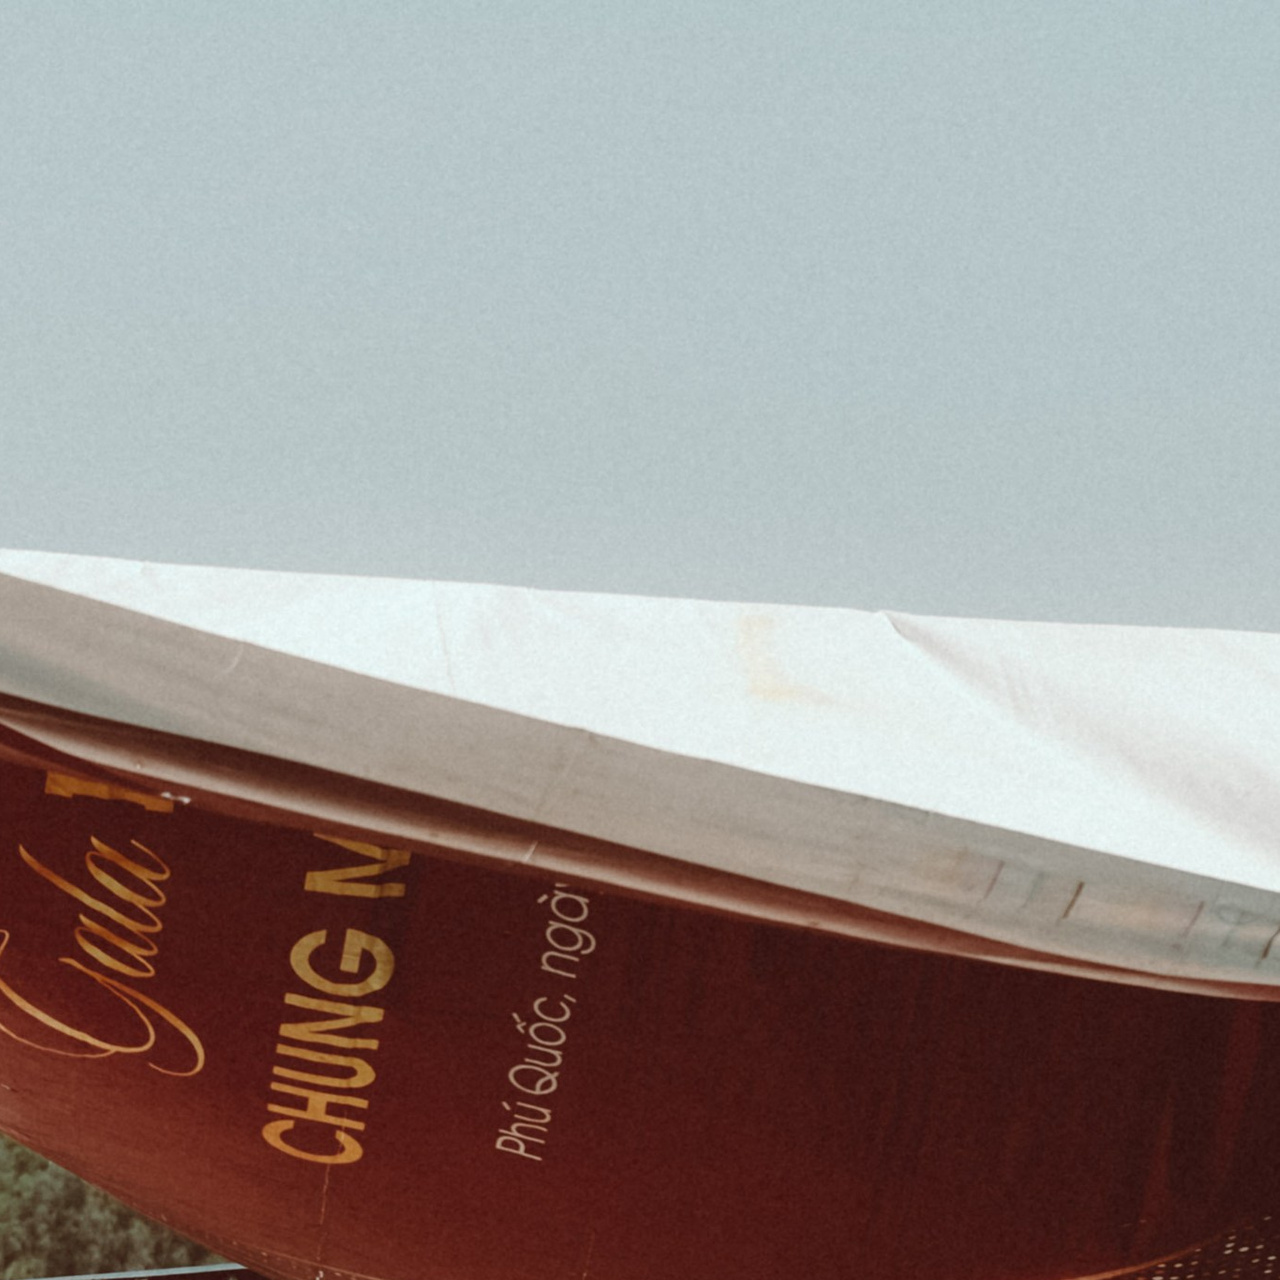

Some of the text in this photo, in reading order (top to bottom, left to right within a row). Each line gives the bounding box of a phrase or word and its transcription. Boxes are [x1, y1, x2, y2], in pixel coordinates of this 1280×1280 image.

[261, 928, 395, 1165] CHUNG
[495, 882, 596, 1161] Phú Quốc, ngà
